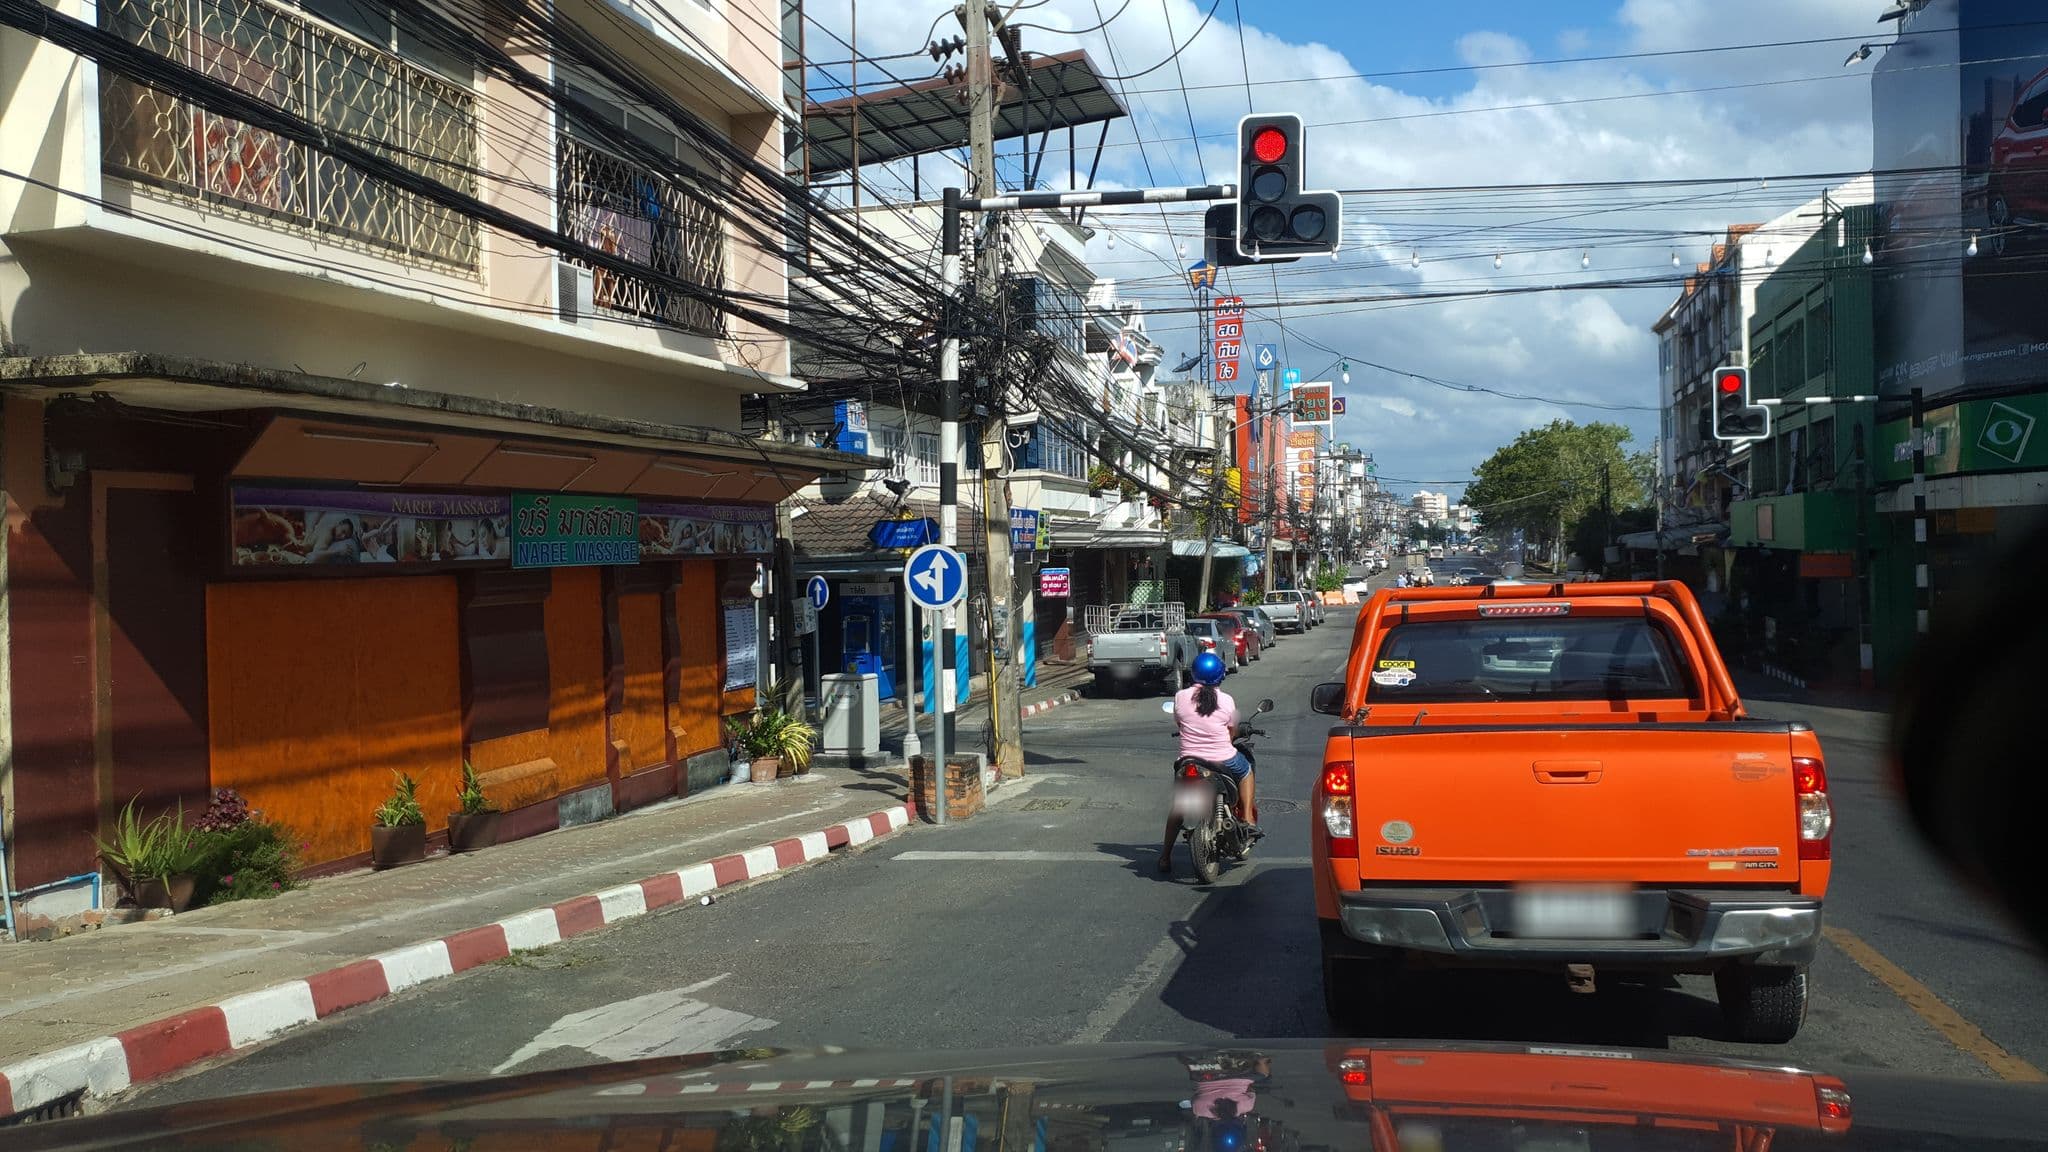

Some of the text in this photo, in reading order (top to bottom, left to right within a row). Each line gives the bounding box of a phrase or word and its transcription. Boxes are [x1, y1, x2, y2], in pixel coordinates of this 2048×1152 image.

[1217, 323, 1239, 336] สด
[1217, 341, 1240, 359] ทัน
[1219, 361, 1235, 379] ใจ
[441, 498, 500, 515] MASSAGE
[518, 541, 637, 564] NAREE MASSAGE
[1376, 846, 1421, 855] ISUZU
